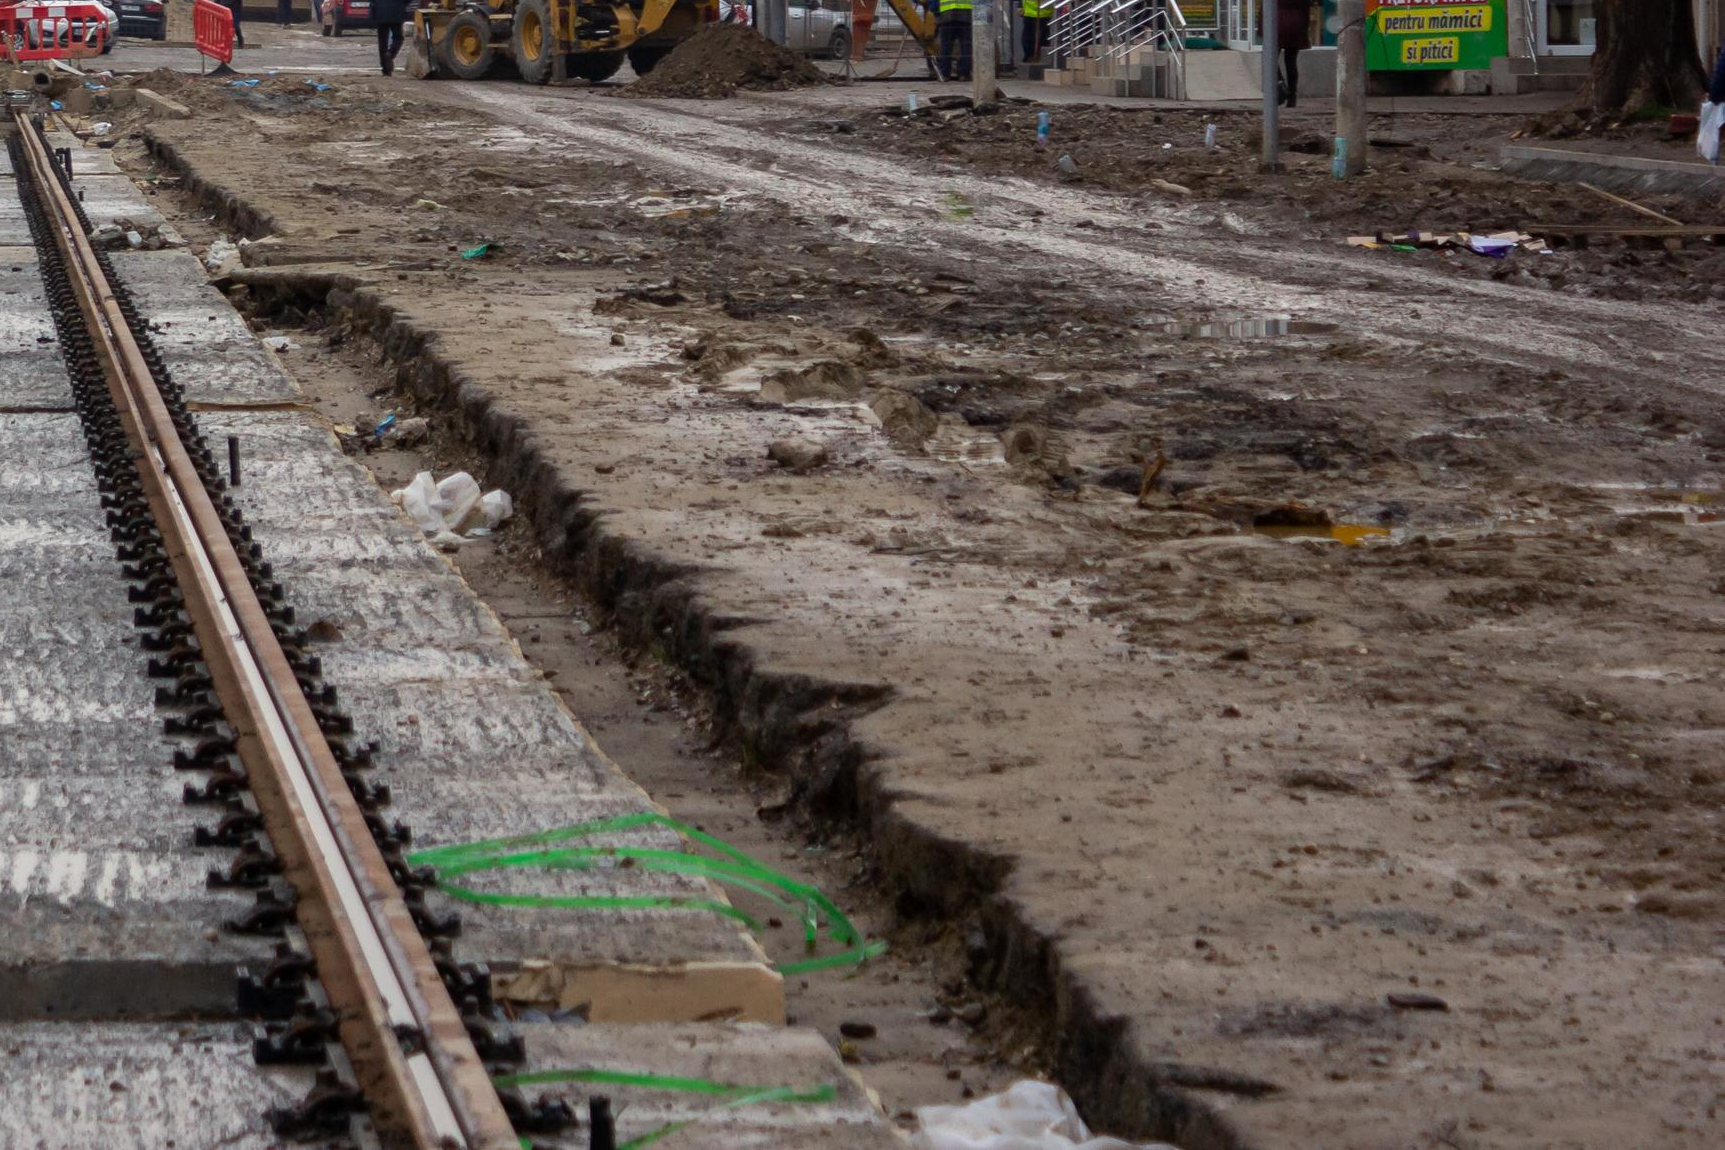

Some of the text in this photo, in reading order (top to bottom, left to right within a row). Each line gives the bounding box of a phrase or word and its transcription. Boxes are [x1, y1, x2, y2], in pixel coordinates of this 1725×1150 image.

[1384, 9, 1483, 36] pentru mămici
[1420, 40, 1454, 65] pitici
